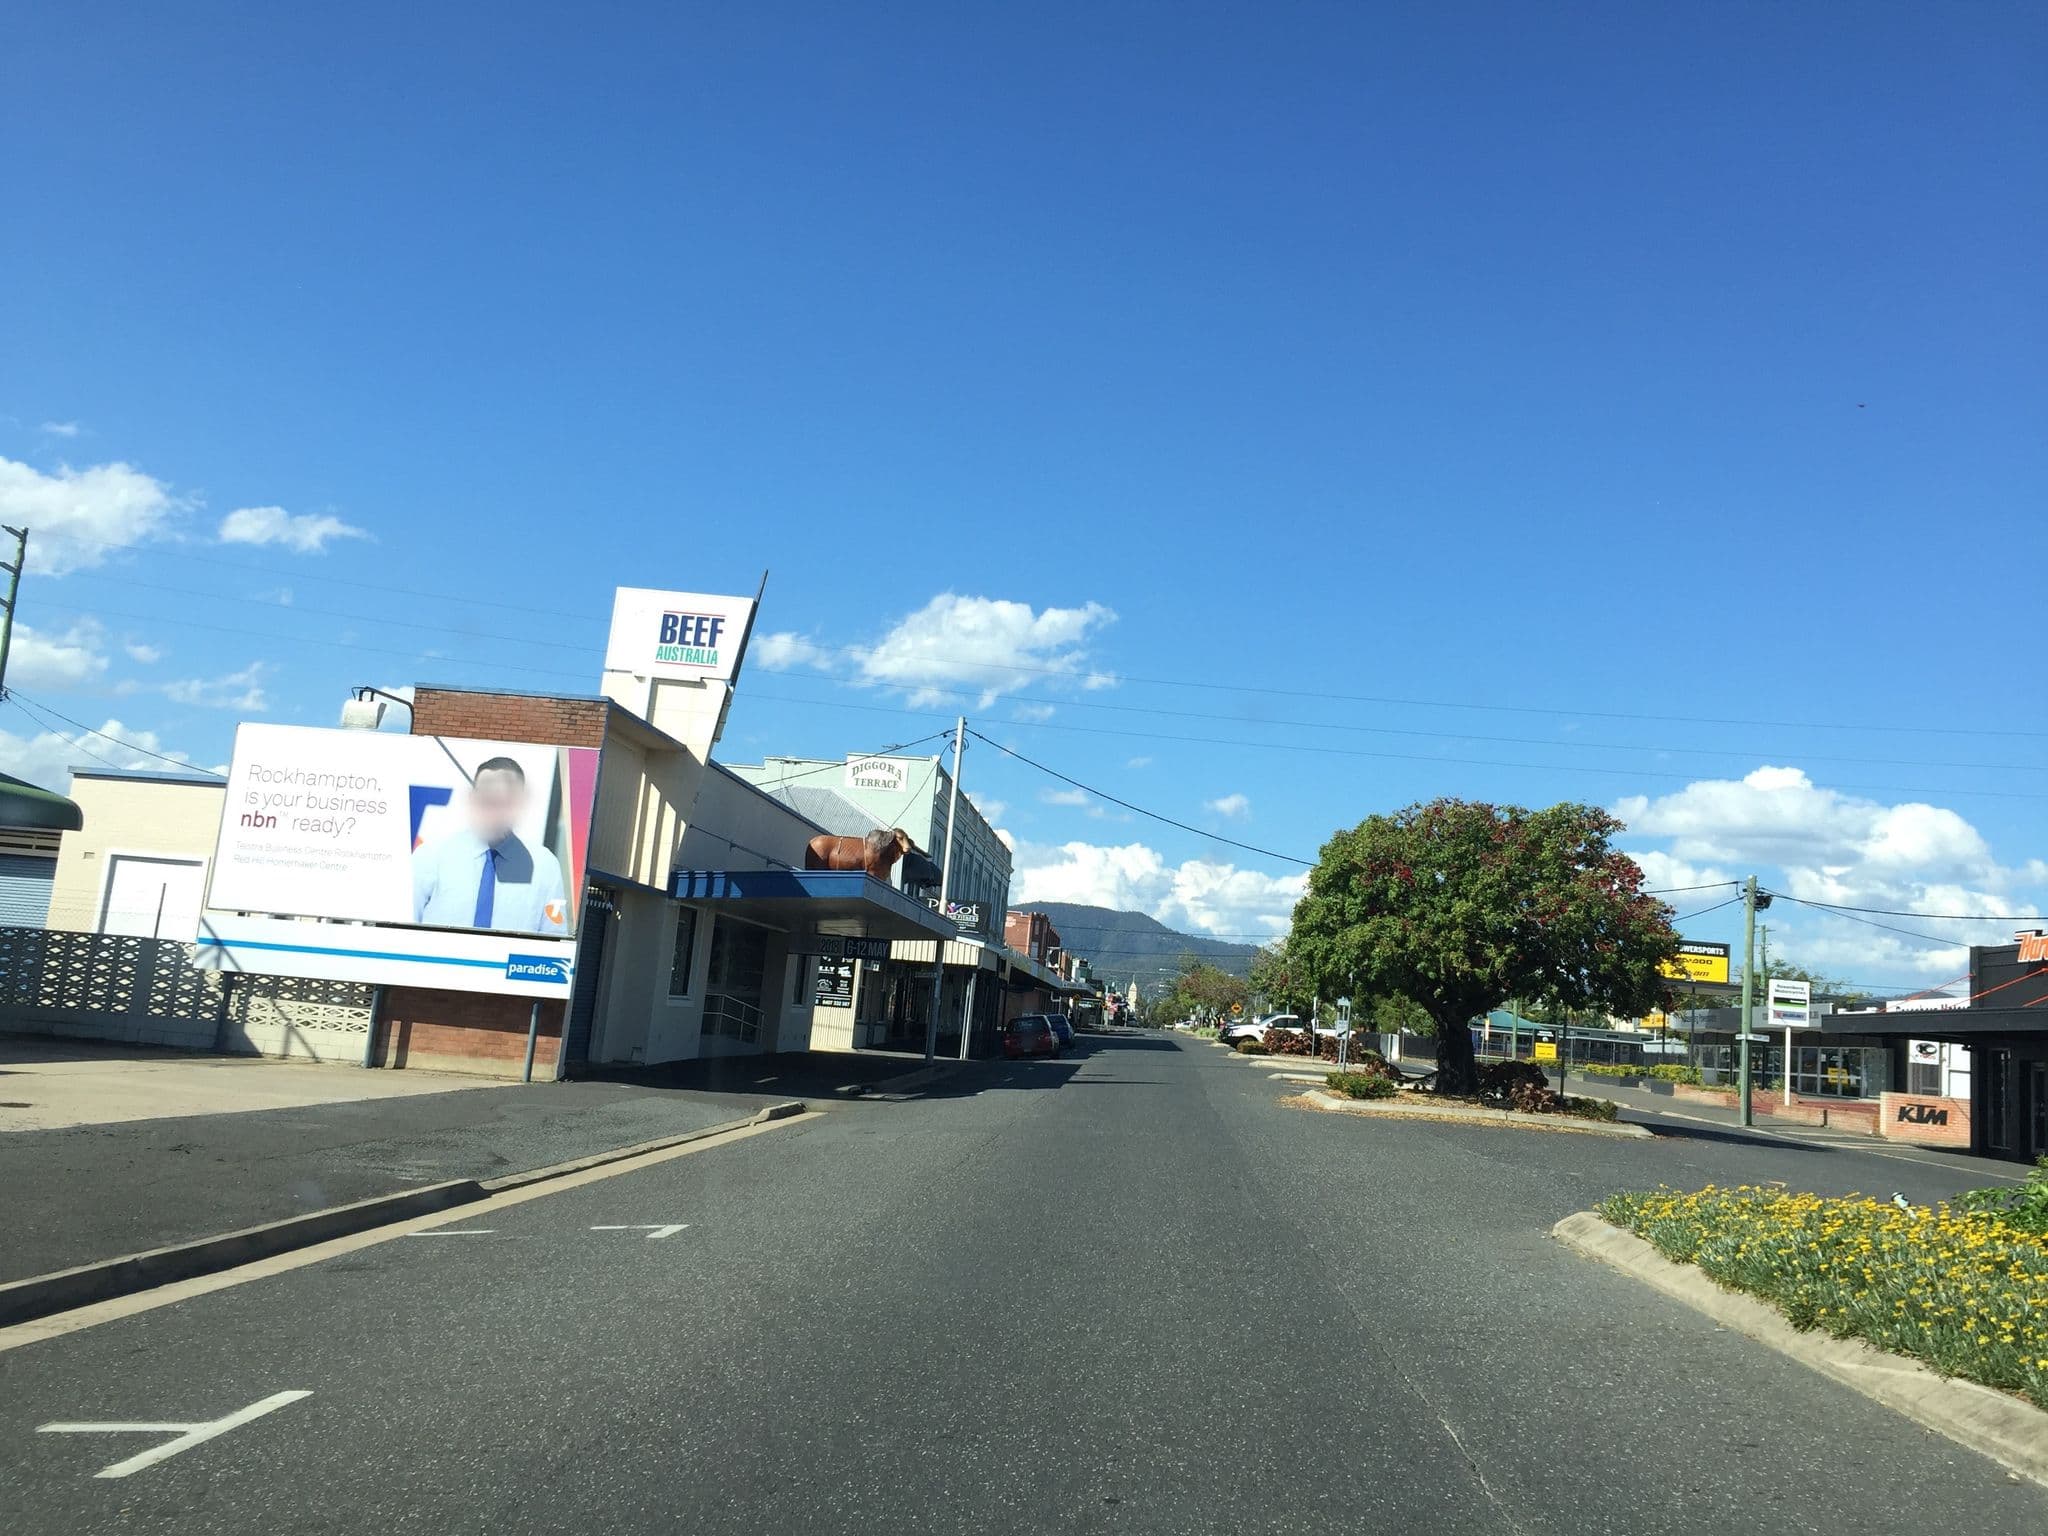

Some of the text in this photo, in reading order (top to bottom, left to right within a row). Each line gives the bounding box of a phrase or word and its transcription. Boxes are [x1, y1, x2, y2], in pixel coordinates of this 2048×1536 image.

[659, 613, 725, 648] BEEF
[655, 645, 718, 665] AUSTRALIA
[851, 761, 902, 781] DIGGORA
[854, 777, 899, 789] TERRACE
[244, 787, 388, 815] is your business
[240, 810, 277, 829] nbn
[291, 816, 356, 839] ready?
[868, 942, 889, 957] MAY
[508, 963, 559, 976] paradise
[1897, 1103, 1948, 1126] KTM
